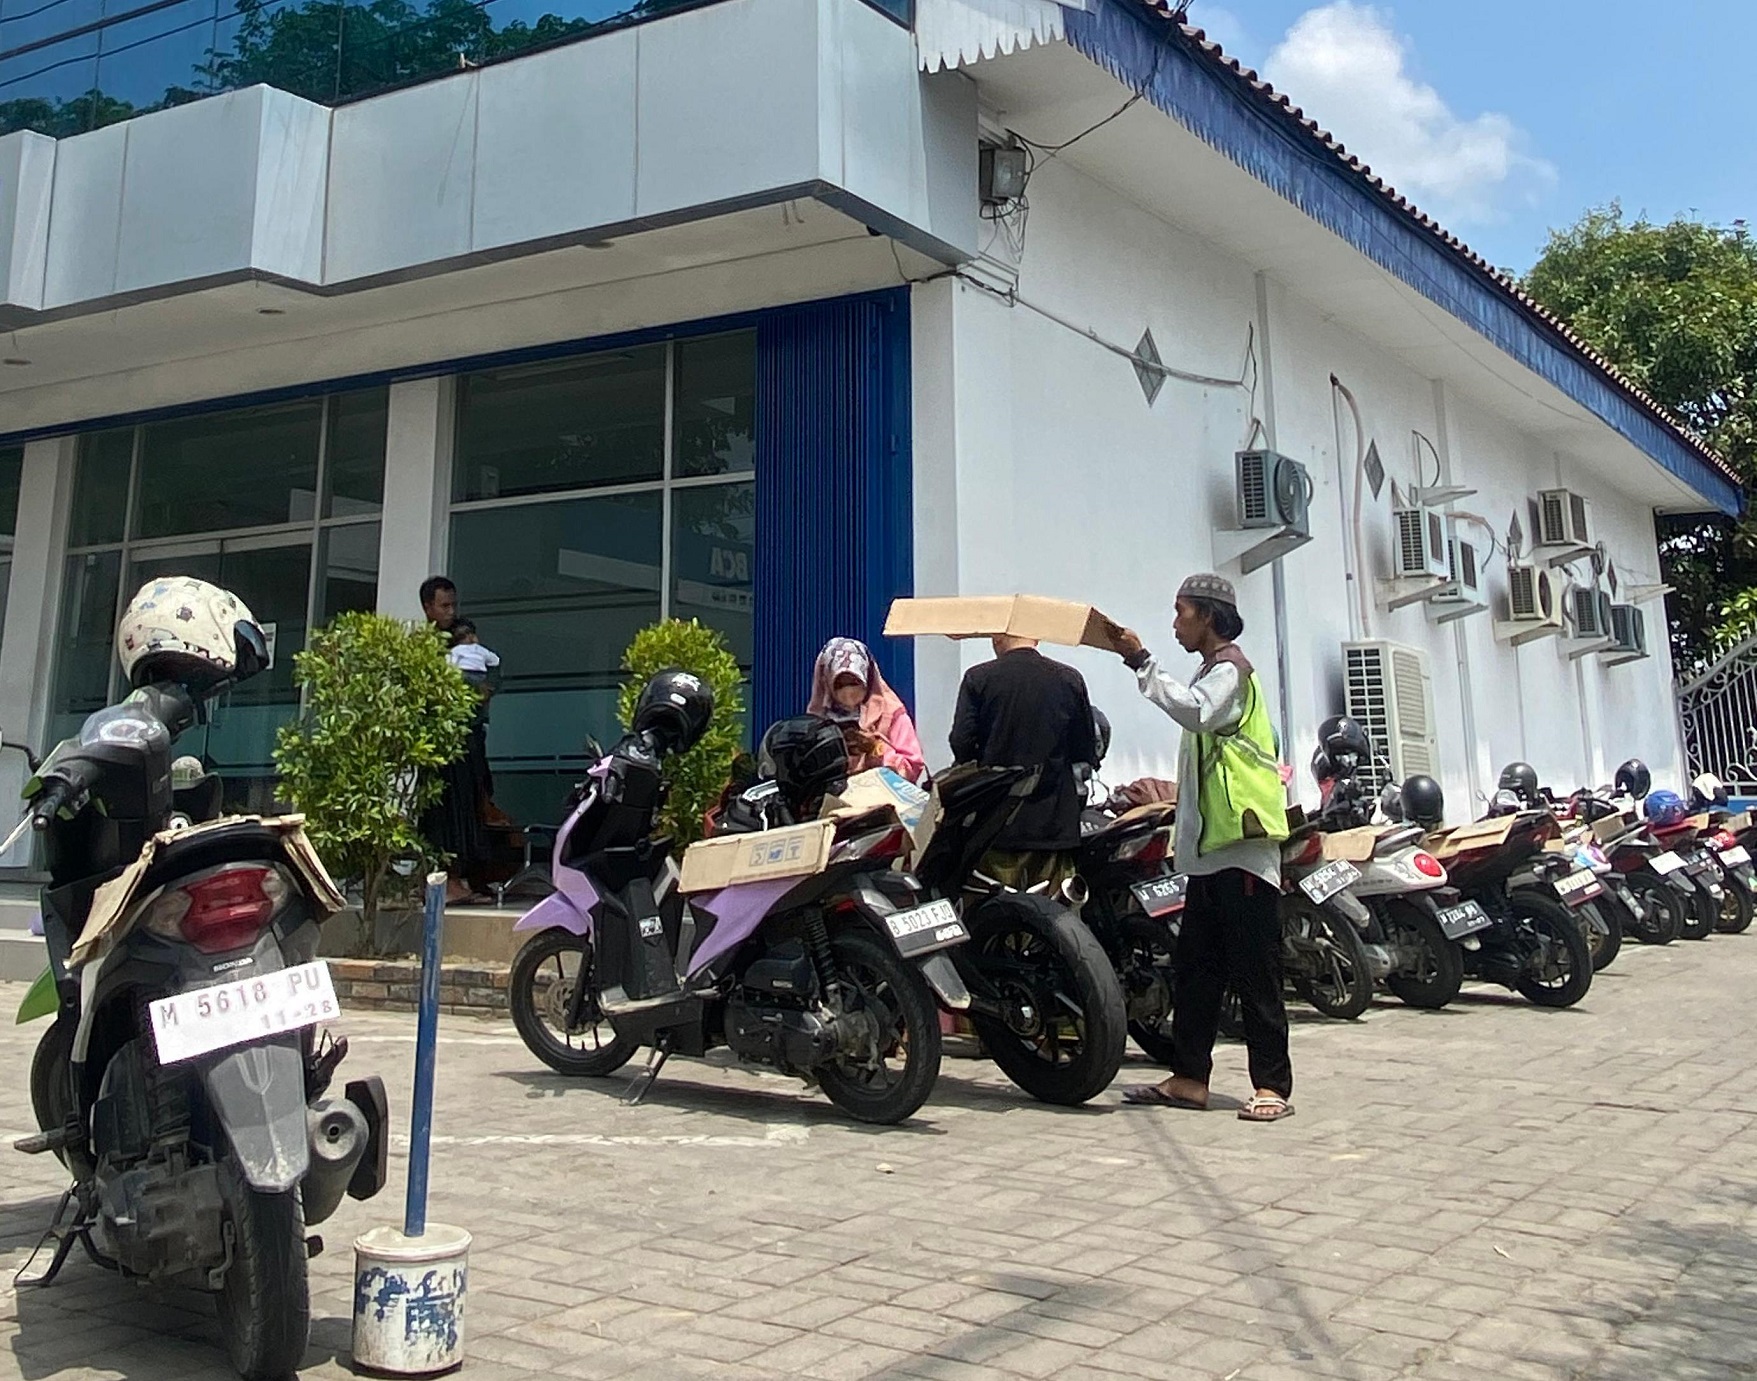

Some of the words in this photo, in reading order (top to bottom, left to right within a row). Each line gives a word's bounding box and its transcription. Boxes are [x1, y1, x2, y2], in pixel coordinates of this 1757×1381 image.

[901, 910, 932, 932] 5023
[160, 1002, 179, 1029] M
[197, 980, 268, 1018] 5618
[288, 967, 321, 996] PU
[260, 999, 333, 1029] 11-28
